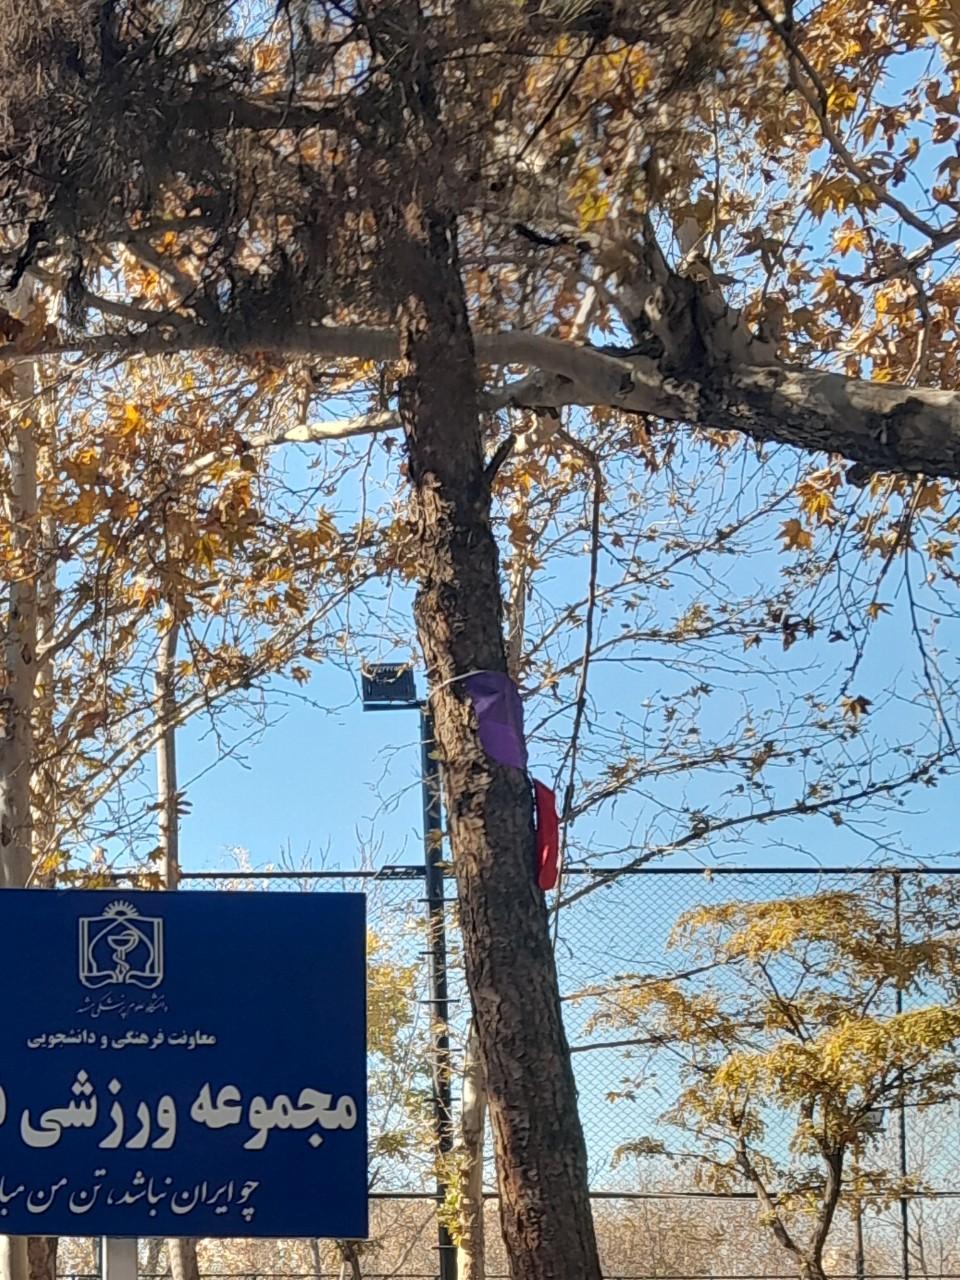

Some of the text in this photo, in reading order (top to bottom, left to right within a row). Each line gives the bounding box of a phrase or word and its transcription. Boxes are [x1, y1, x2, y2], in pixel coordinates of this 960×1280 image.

[26, 1028, 217, 1050] معاونت فرهنگی و دانشجویی
[19, 1069, 178, 1149] ورزشی
[189, 1081, 359, 1150] مجموعه
[26, 1177, 68, 1214] من
[68, 1168, 107, 1214] تن
[170, 1180, 234, 1215] ایران
[236, 1179, 260, 1222] چو
